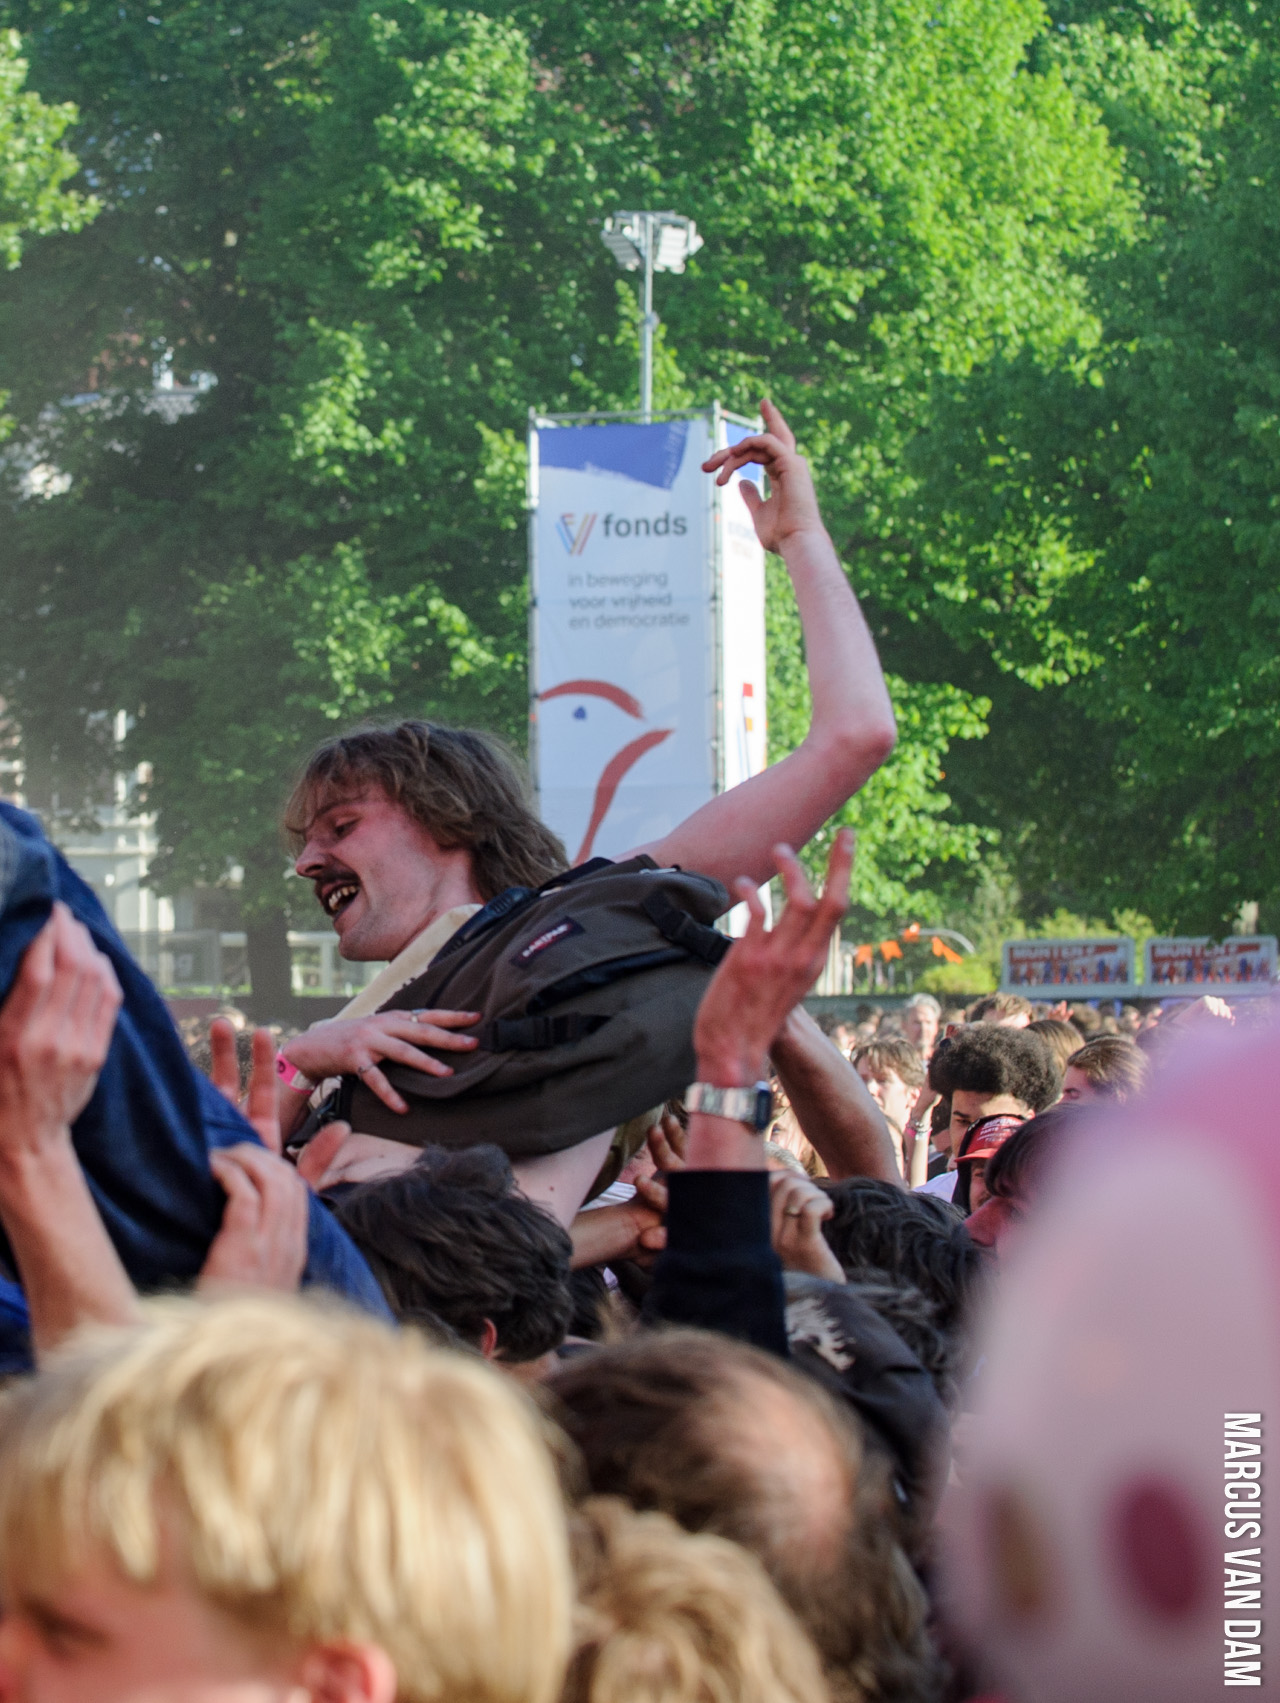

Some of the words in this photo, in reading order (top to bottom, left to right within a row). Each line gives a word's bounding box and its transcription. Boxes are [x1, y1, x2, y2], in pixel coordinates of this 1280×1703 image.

[603, 510, 688, 538] fonds
[567, 572, 583, 588] in
[586, 571, 669, 590] beweging
[568, 597, 606, 609] voor
[568, 616, 591, 630] en
[594, 613, 691, 630] democratie
